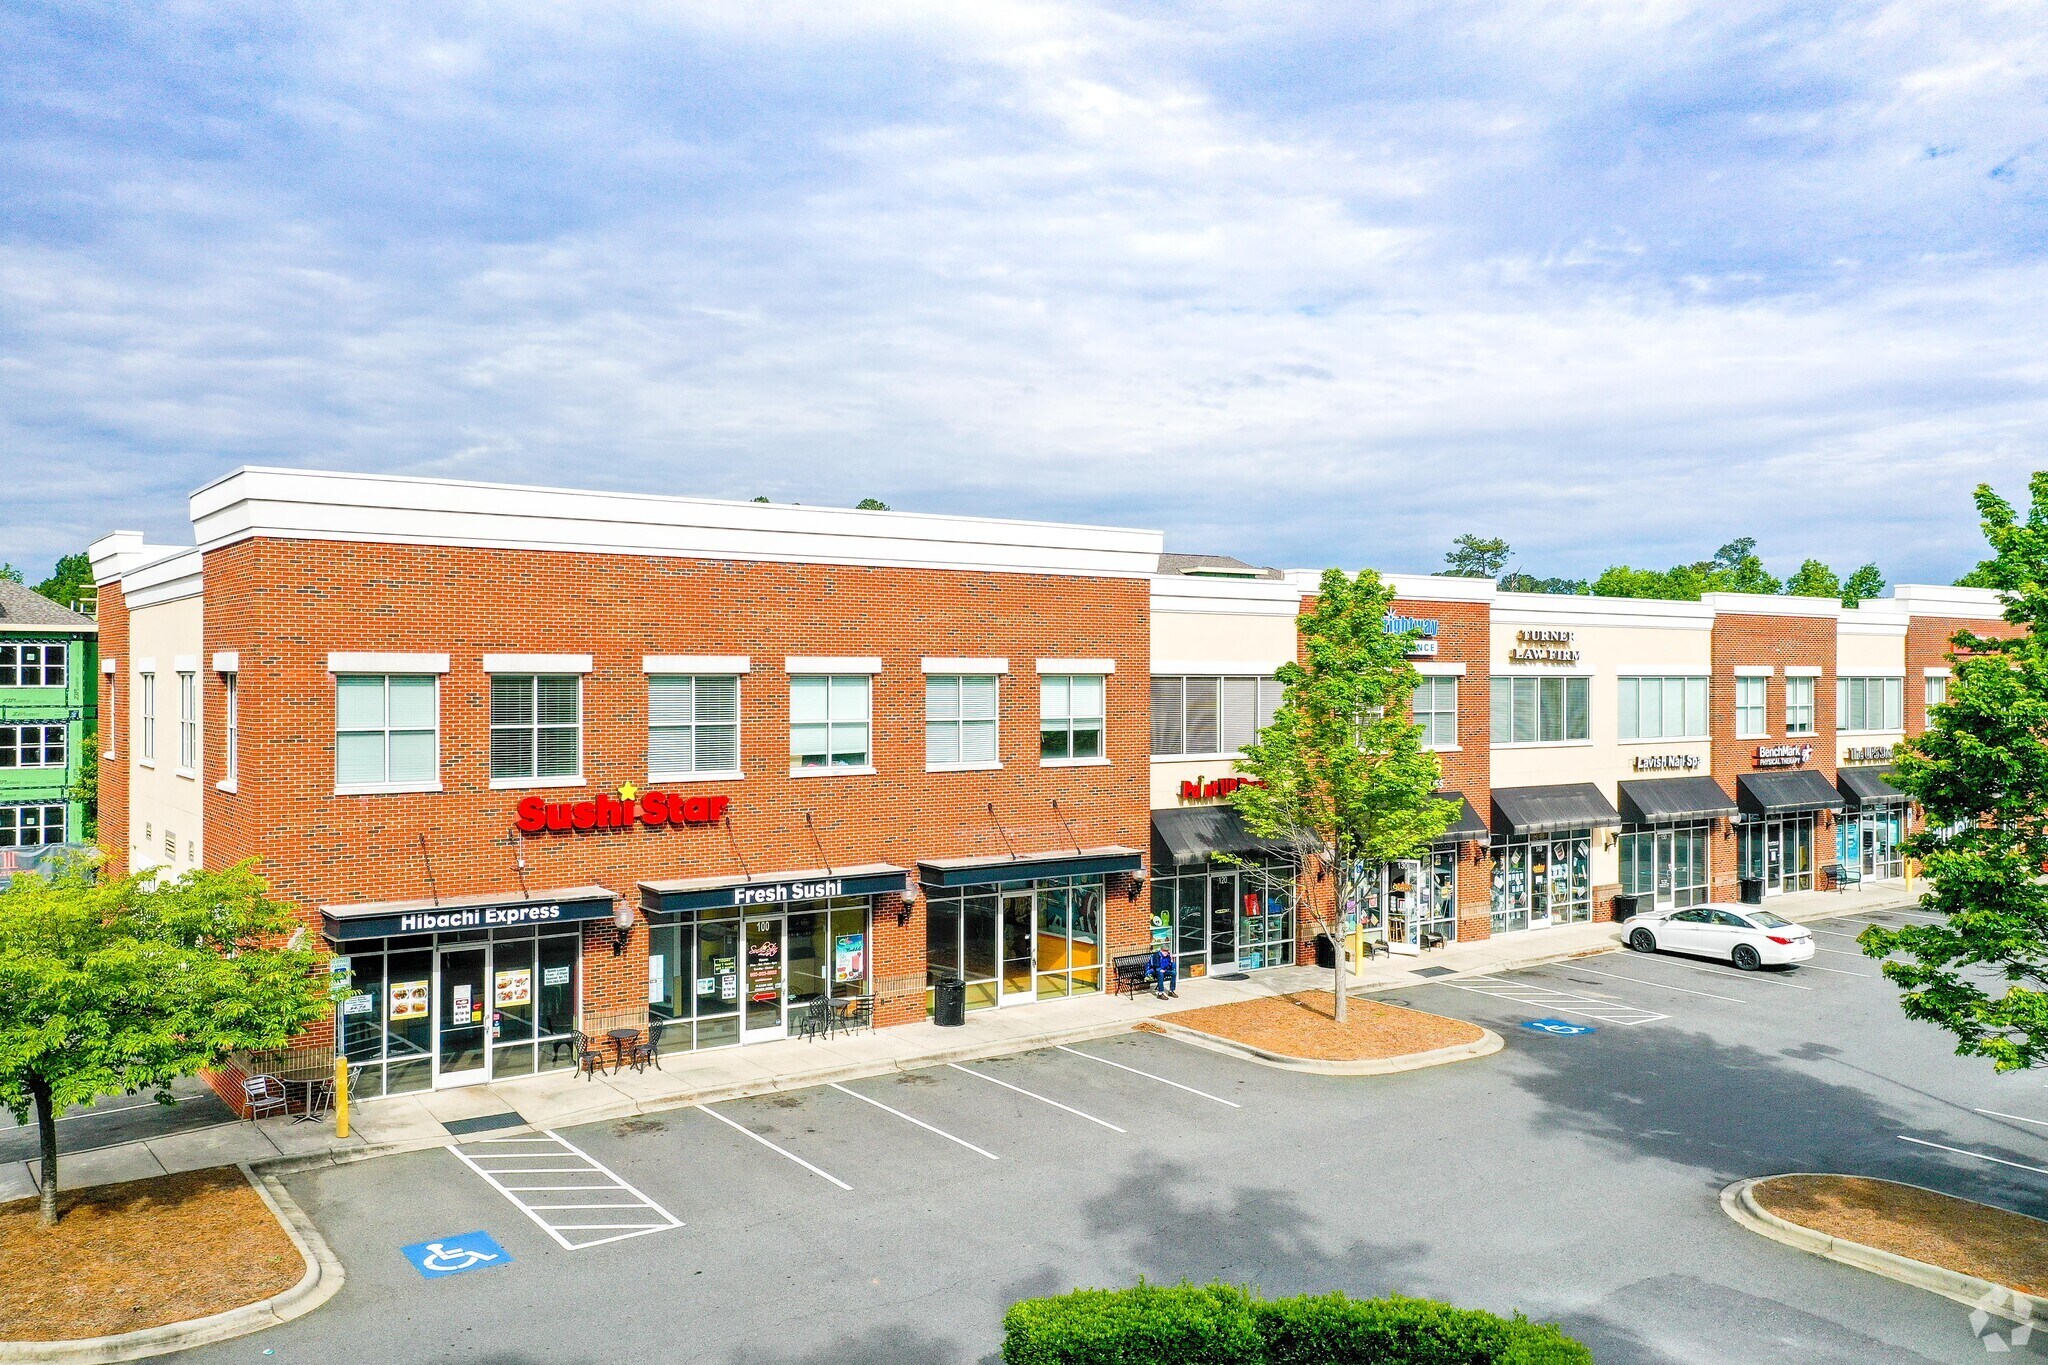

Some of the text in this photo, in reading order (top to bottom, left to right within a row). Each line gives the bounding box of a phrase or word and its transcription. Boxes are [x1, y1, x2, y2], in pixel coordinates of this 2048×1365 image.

[1523, 631, 1575, 641] TURNER
[1515, 649, 1581, 660] LAW FIRM
[1759, 745, 1801, 758] BenchMark
[1851, 747, 1864, 760] The
[1864, 746, 1880, 760] UPS
[1637, 754, 1702, 768] Lavish Nail Spa
[1759, 757, 1801, 766] PHYSICAL THERAPY
[517, 781, 730, 831] Sushi Star
[1218, 876, 1228, 884] 120
[734, 879, 842, 905] Fresh Sushi
[401, 905, 560, 931] Hibachi Express
[756, 921, 770, 932] 100
